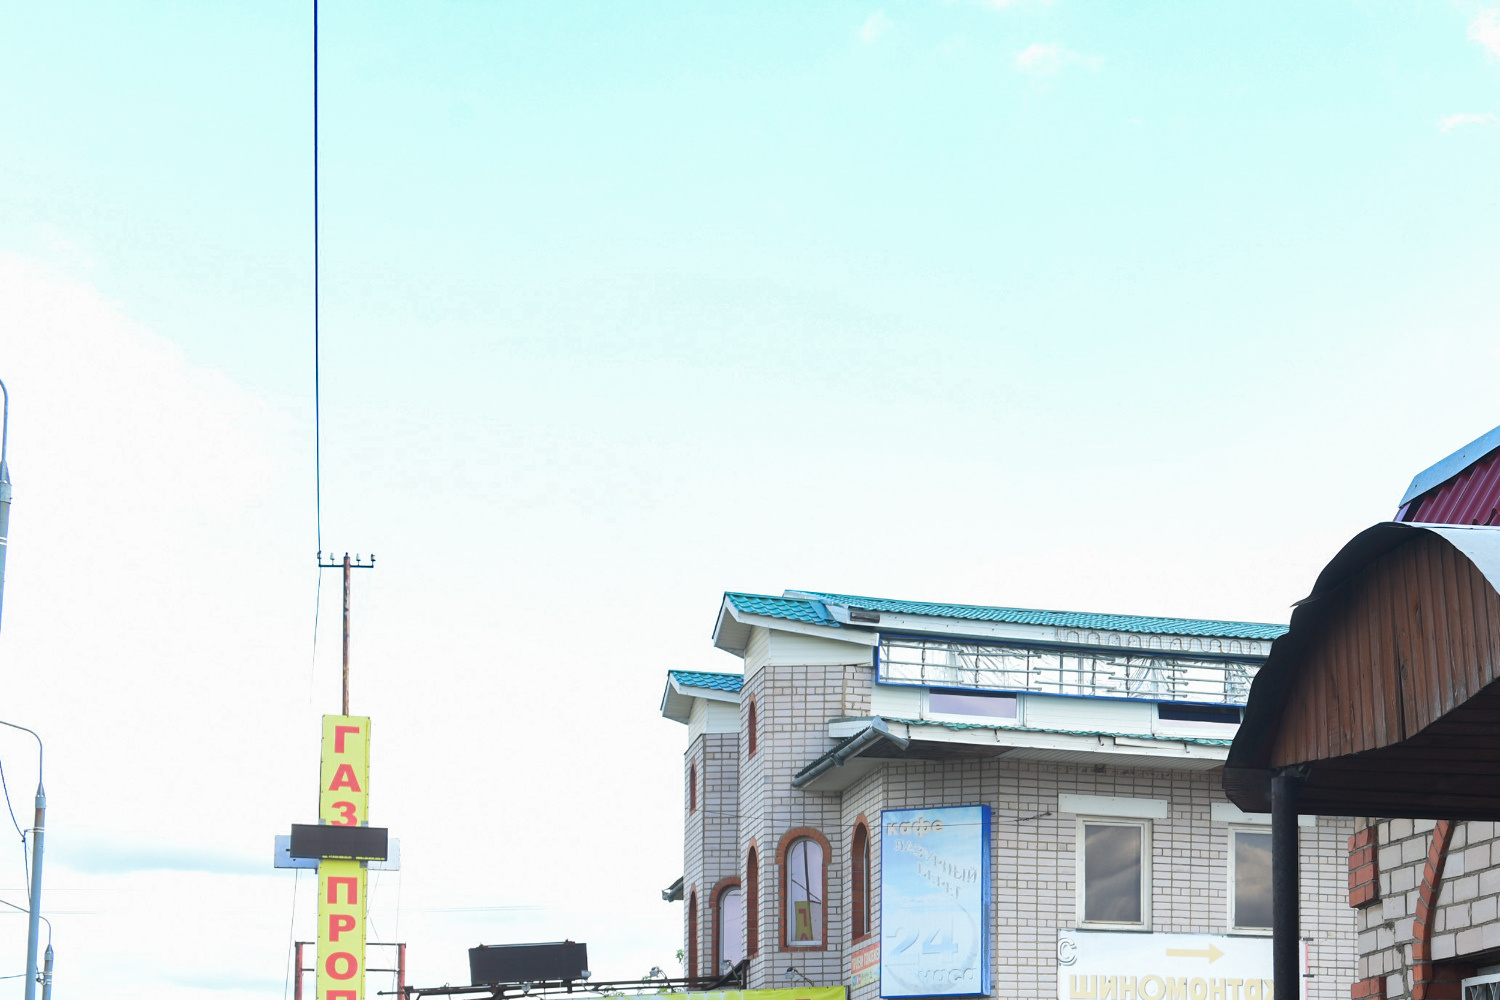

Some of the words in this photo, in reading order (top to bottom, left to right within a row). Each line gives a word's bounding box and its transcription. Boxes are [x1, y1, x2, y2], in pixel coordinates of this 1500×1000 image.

[328, 725, 361, 828] ГАЗ
[887, 817, 945, 838] кафе
[885, 914, 959, 966] 24
